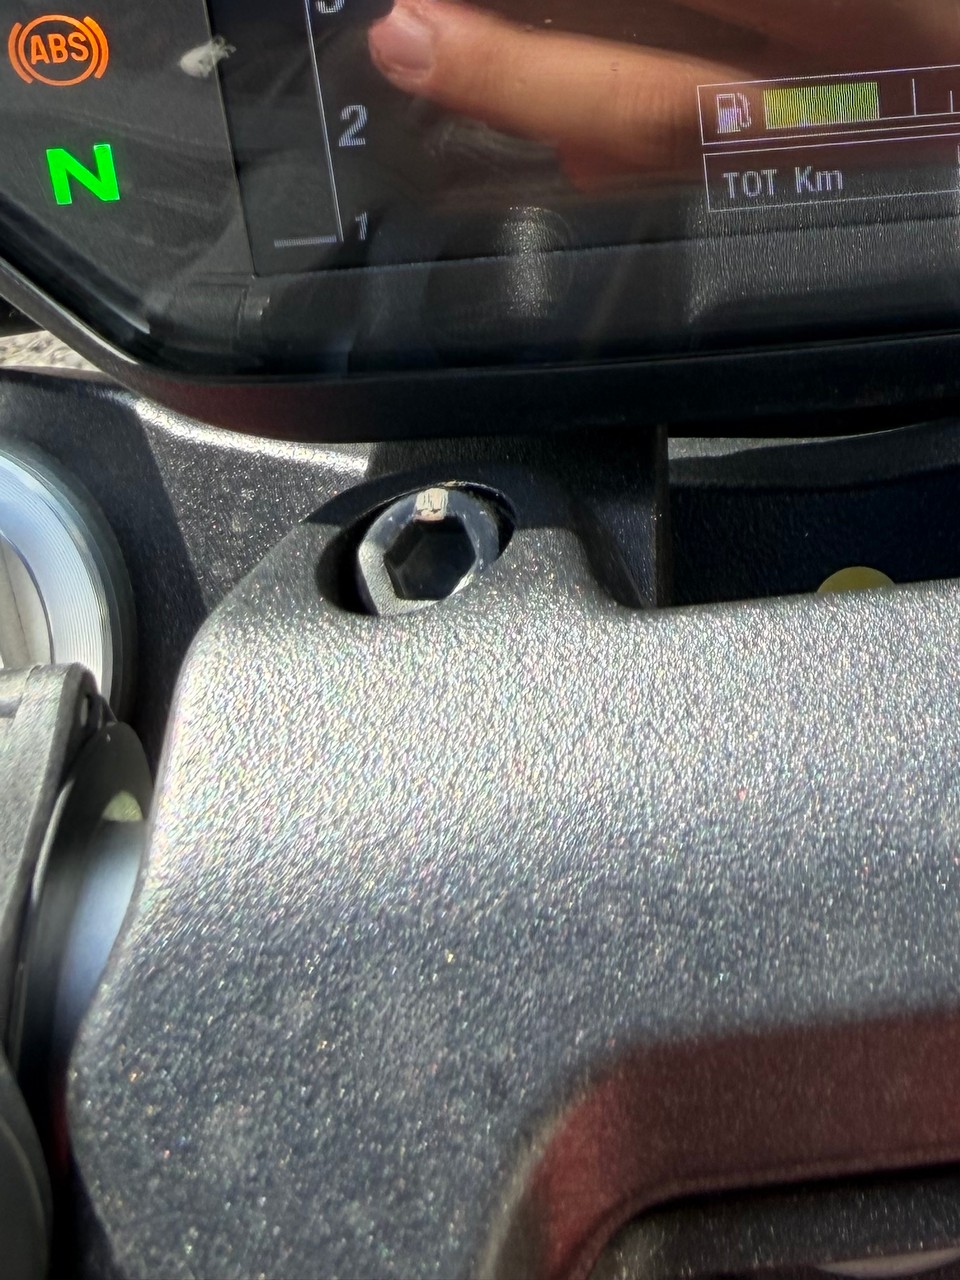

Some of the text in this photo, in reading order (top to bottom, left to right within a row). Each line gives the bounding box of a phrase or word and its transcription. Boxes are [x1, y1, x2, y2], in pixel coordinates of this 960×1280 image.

[30, 32, 89, 64] ABS
[338, 104, 368, 147] 2
[46, 143, 120, 205] N
[721, 167, 844, 198] TOT Km
[355, 212, 368, 240] 1
